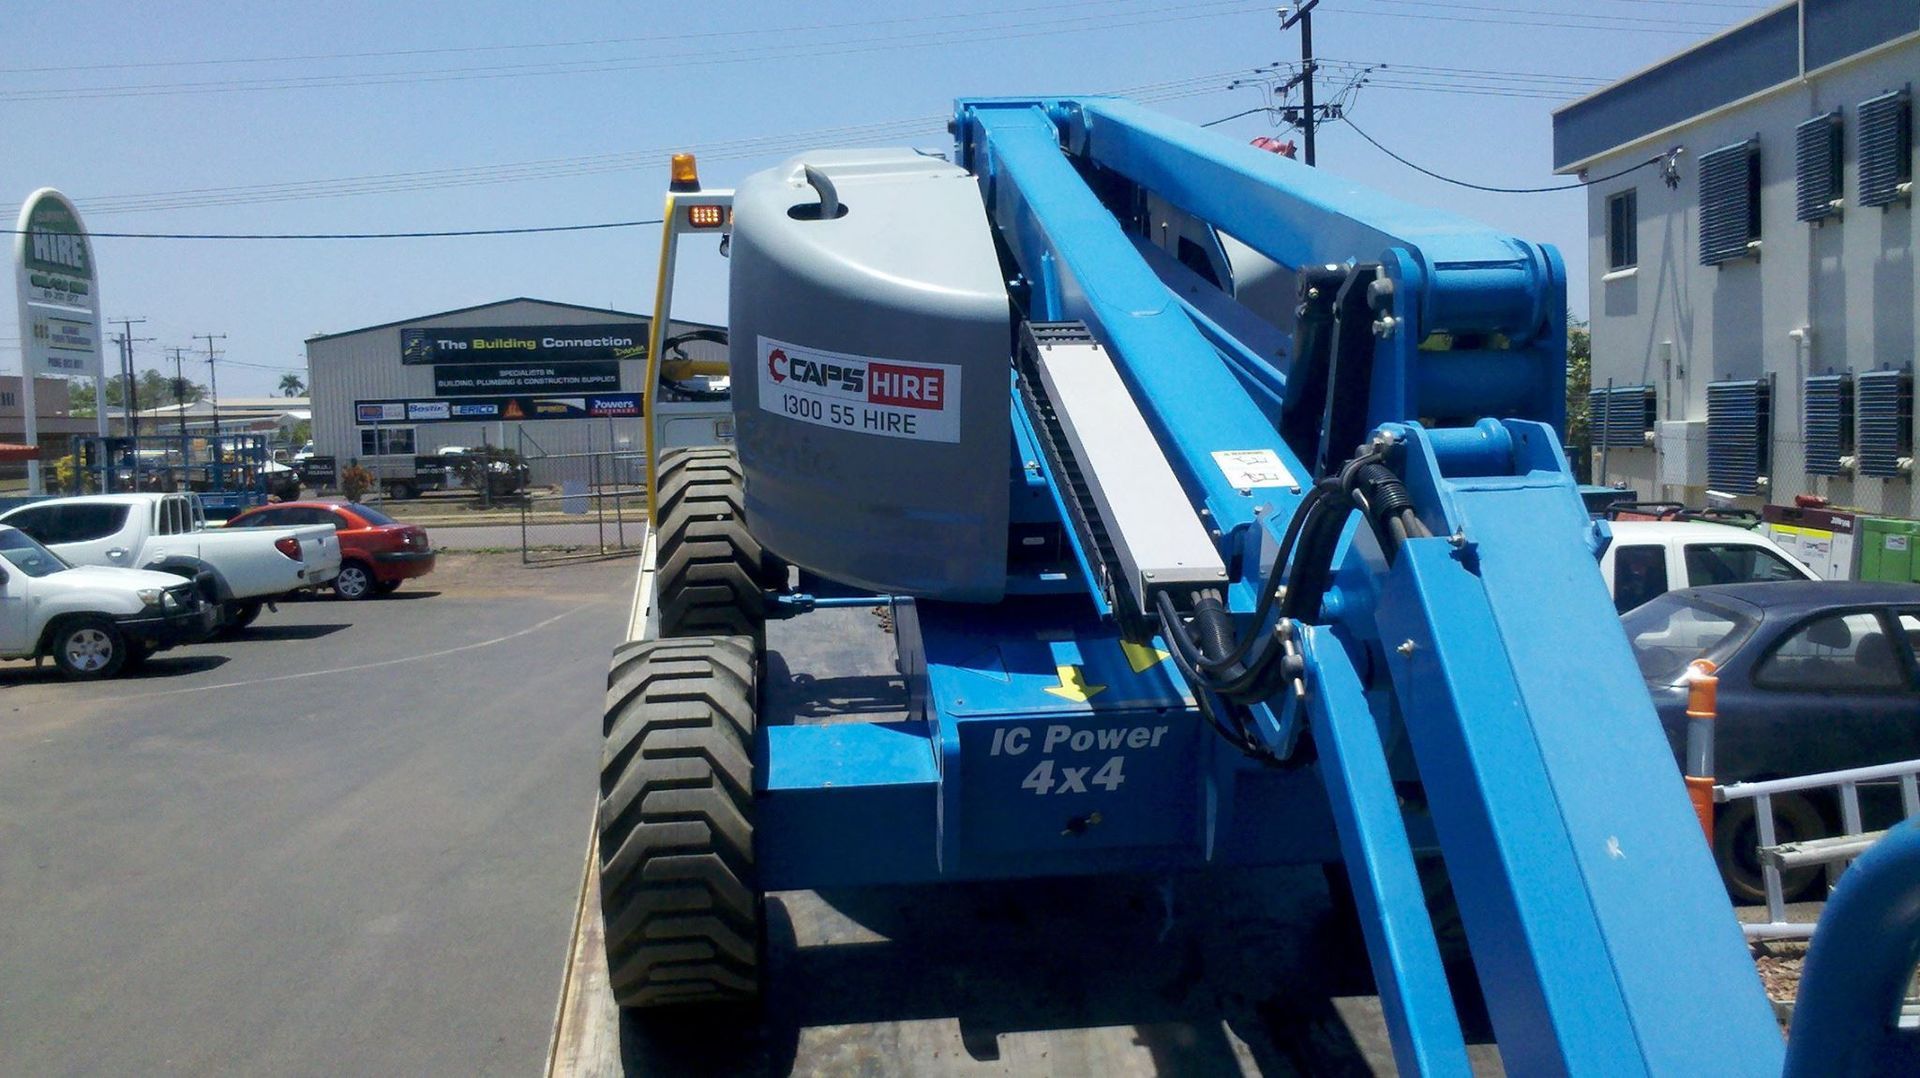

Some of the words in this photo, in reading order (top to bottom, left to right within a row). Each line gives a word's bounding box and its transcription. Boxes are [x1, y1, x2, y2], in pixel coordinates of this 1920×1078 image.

[33, 225, 83, 269] HIRE
[437, 340, 467, 350] The
[472, 339, 536, 350] Building
[542, 337, 633, 348] Connection
[437, 379, 475, 387] BUILDING,
[523, 377, 580, 385] CONSTRUCTION
[581, 375, 616, 383] SUPPLIES
[872, 371, 939, 401] HIRE
[460, 405, 495, 414] ERICO
[594, 400, 633, 409] Powers
[783, 393, 822, 420] 1300
[830, 404, 855, 426] 55
[864, 409, 916, 434] HIRE
[990, 727, 1032, 756] IC
[1043, 725, 1169, 753] Power
[1021, 756, 1126, 795] 4x4
